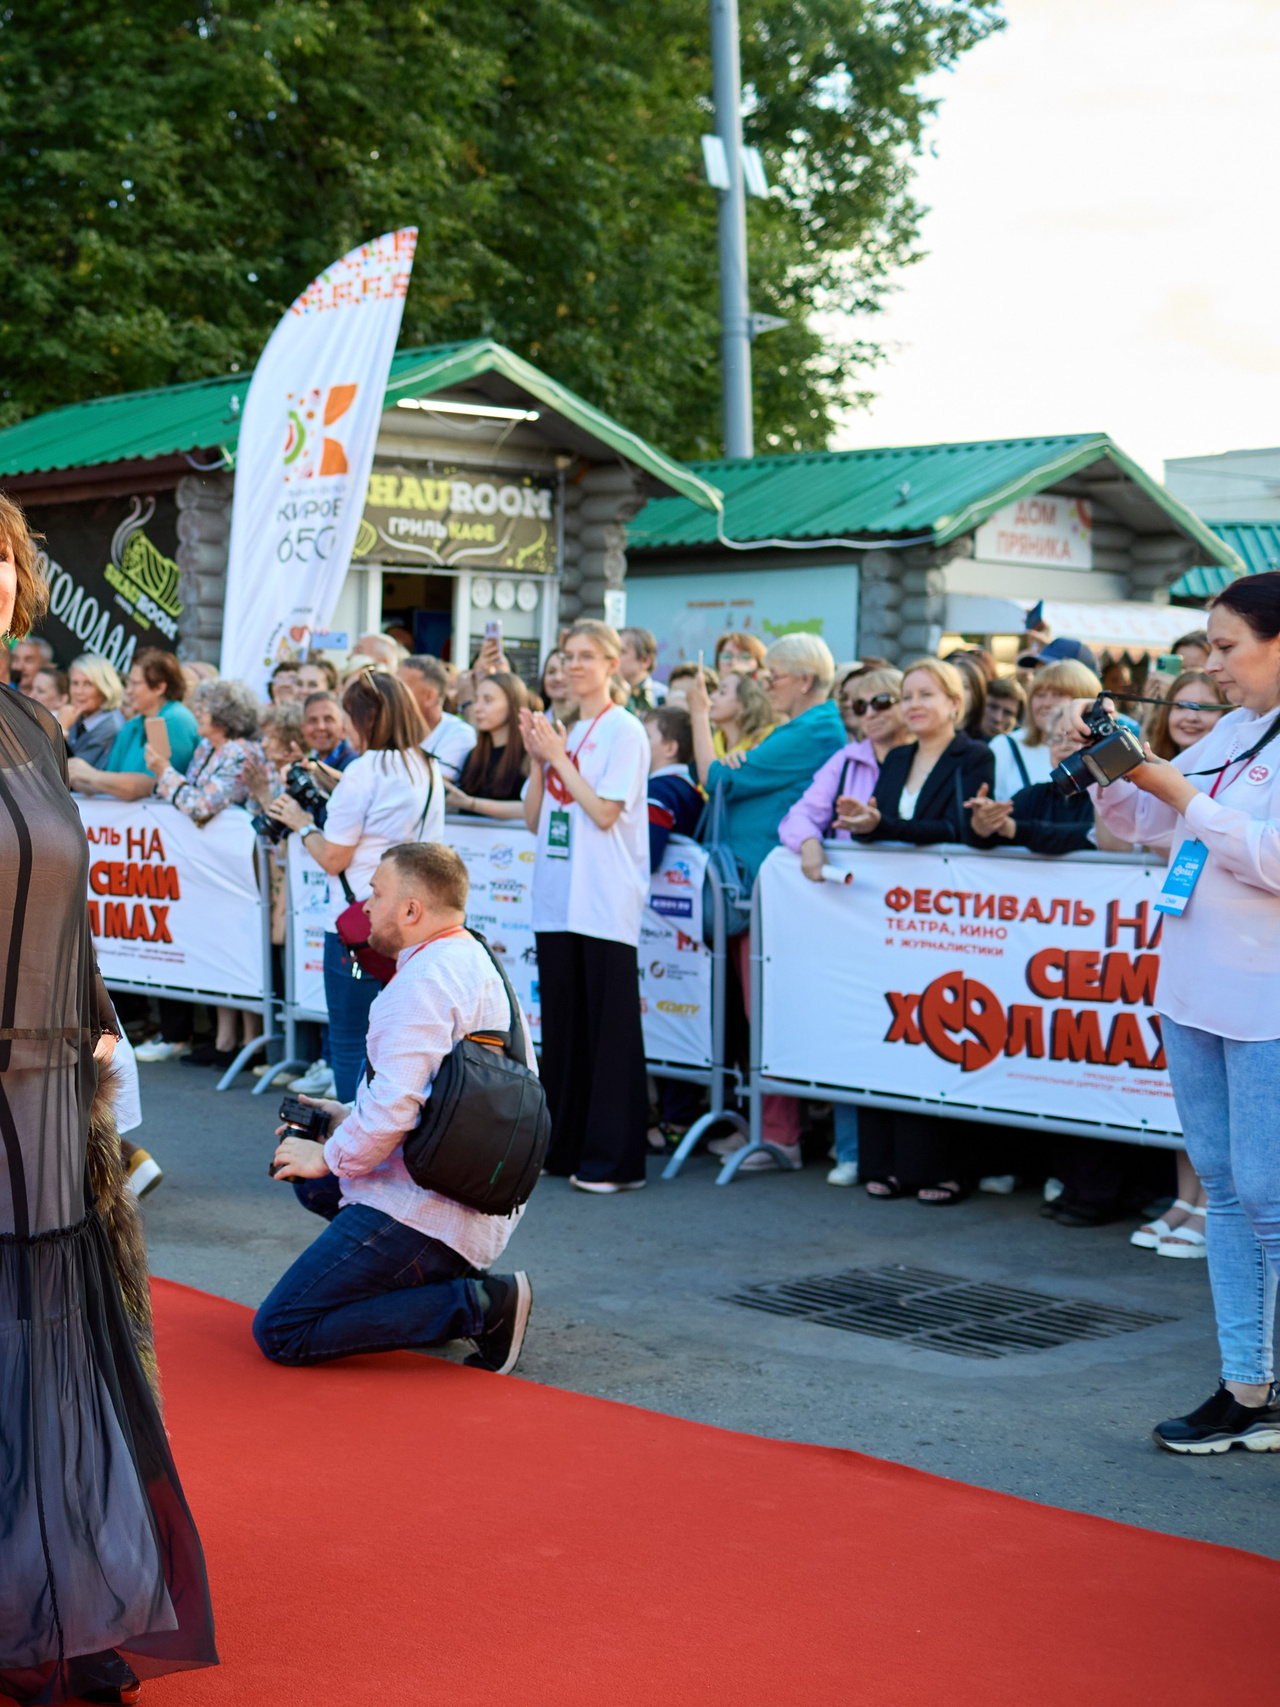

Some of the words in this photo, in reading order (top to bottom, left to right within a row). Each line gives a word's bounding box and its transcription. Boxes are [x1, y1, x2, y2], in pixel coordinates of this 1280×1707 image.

[366, 473, 552, 520] HAUROOM
[1015, 501, 1056, 526] ДОМ
[277, 526, 336, 564] 650
[388, 516, 448, 539] ГРИЛЬ
[448, 520, 496, 542] КАФЕ
[995, 531, 1072, 560] ПРЯНИКА
[31, 545, 137, 675] ОГОЛОДАЛ
[127, 826, 167, 862] НА
[89, 860, 180, 901] СЕМИ
[885, 886, 1096, 927] ФЕСТИВАЛЬ
[886, 917, 956, 937] ТЕАТРА,
[960, 924, 1008, 940] КИНО
[901, 937, 1004, 957] ЖУРНАЛИСТИКИ
